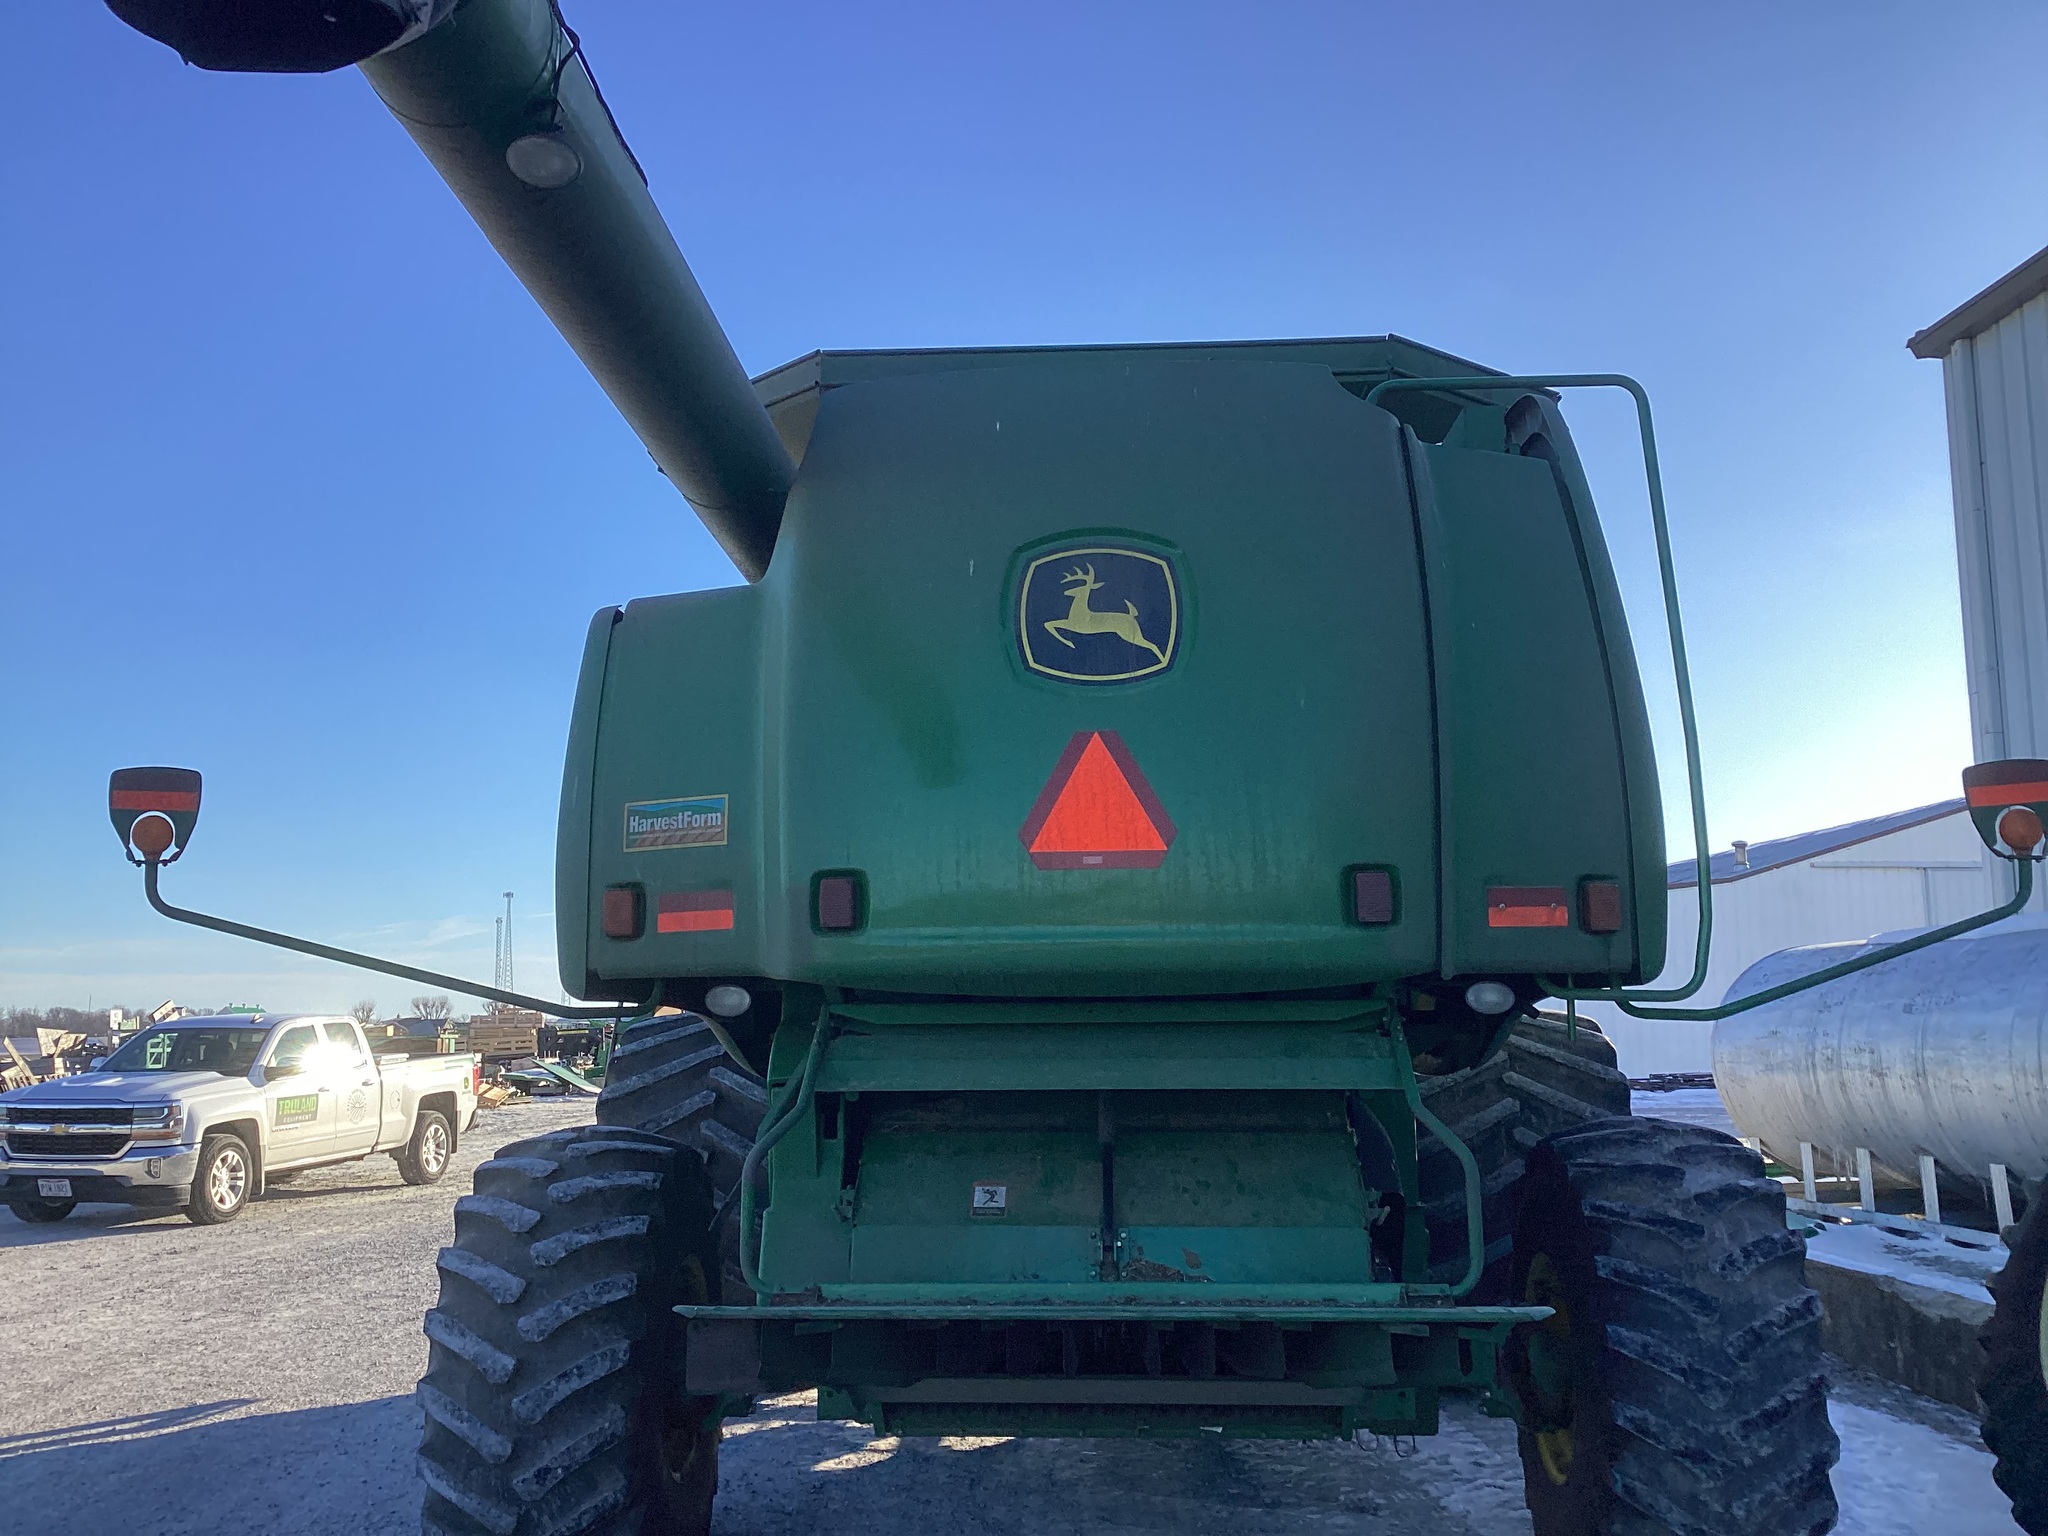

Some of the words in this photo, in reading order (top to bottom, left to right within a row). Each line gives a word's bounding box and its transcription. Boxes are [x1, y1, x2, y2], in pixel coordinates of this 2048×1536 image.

[629, 811, 721, 832] HarvestForm
[279, 1097, 317, 1115] TRULAND
[283, 1114, 312, 1123] EQUIPMENT
